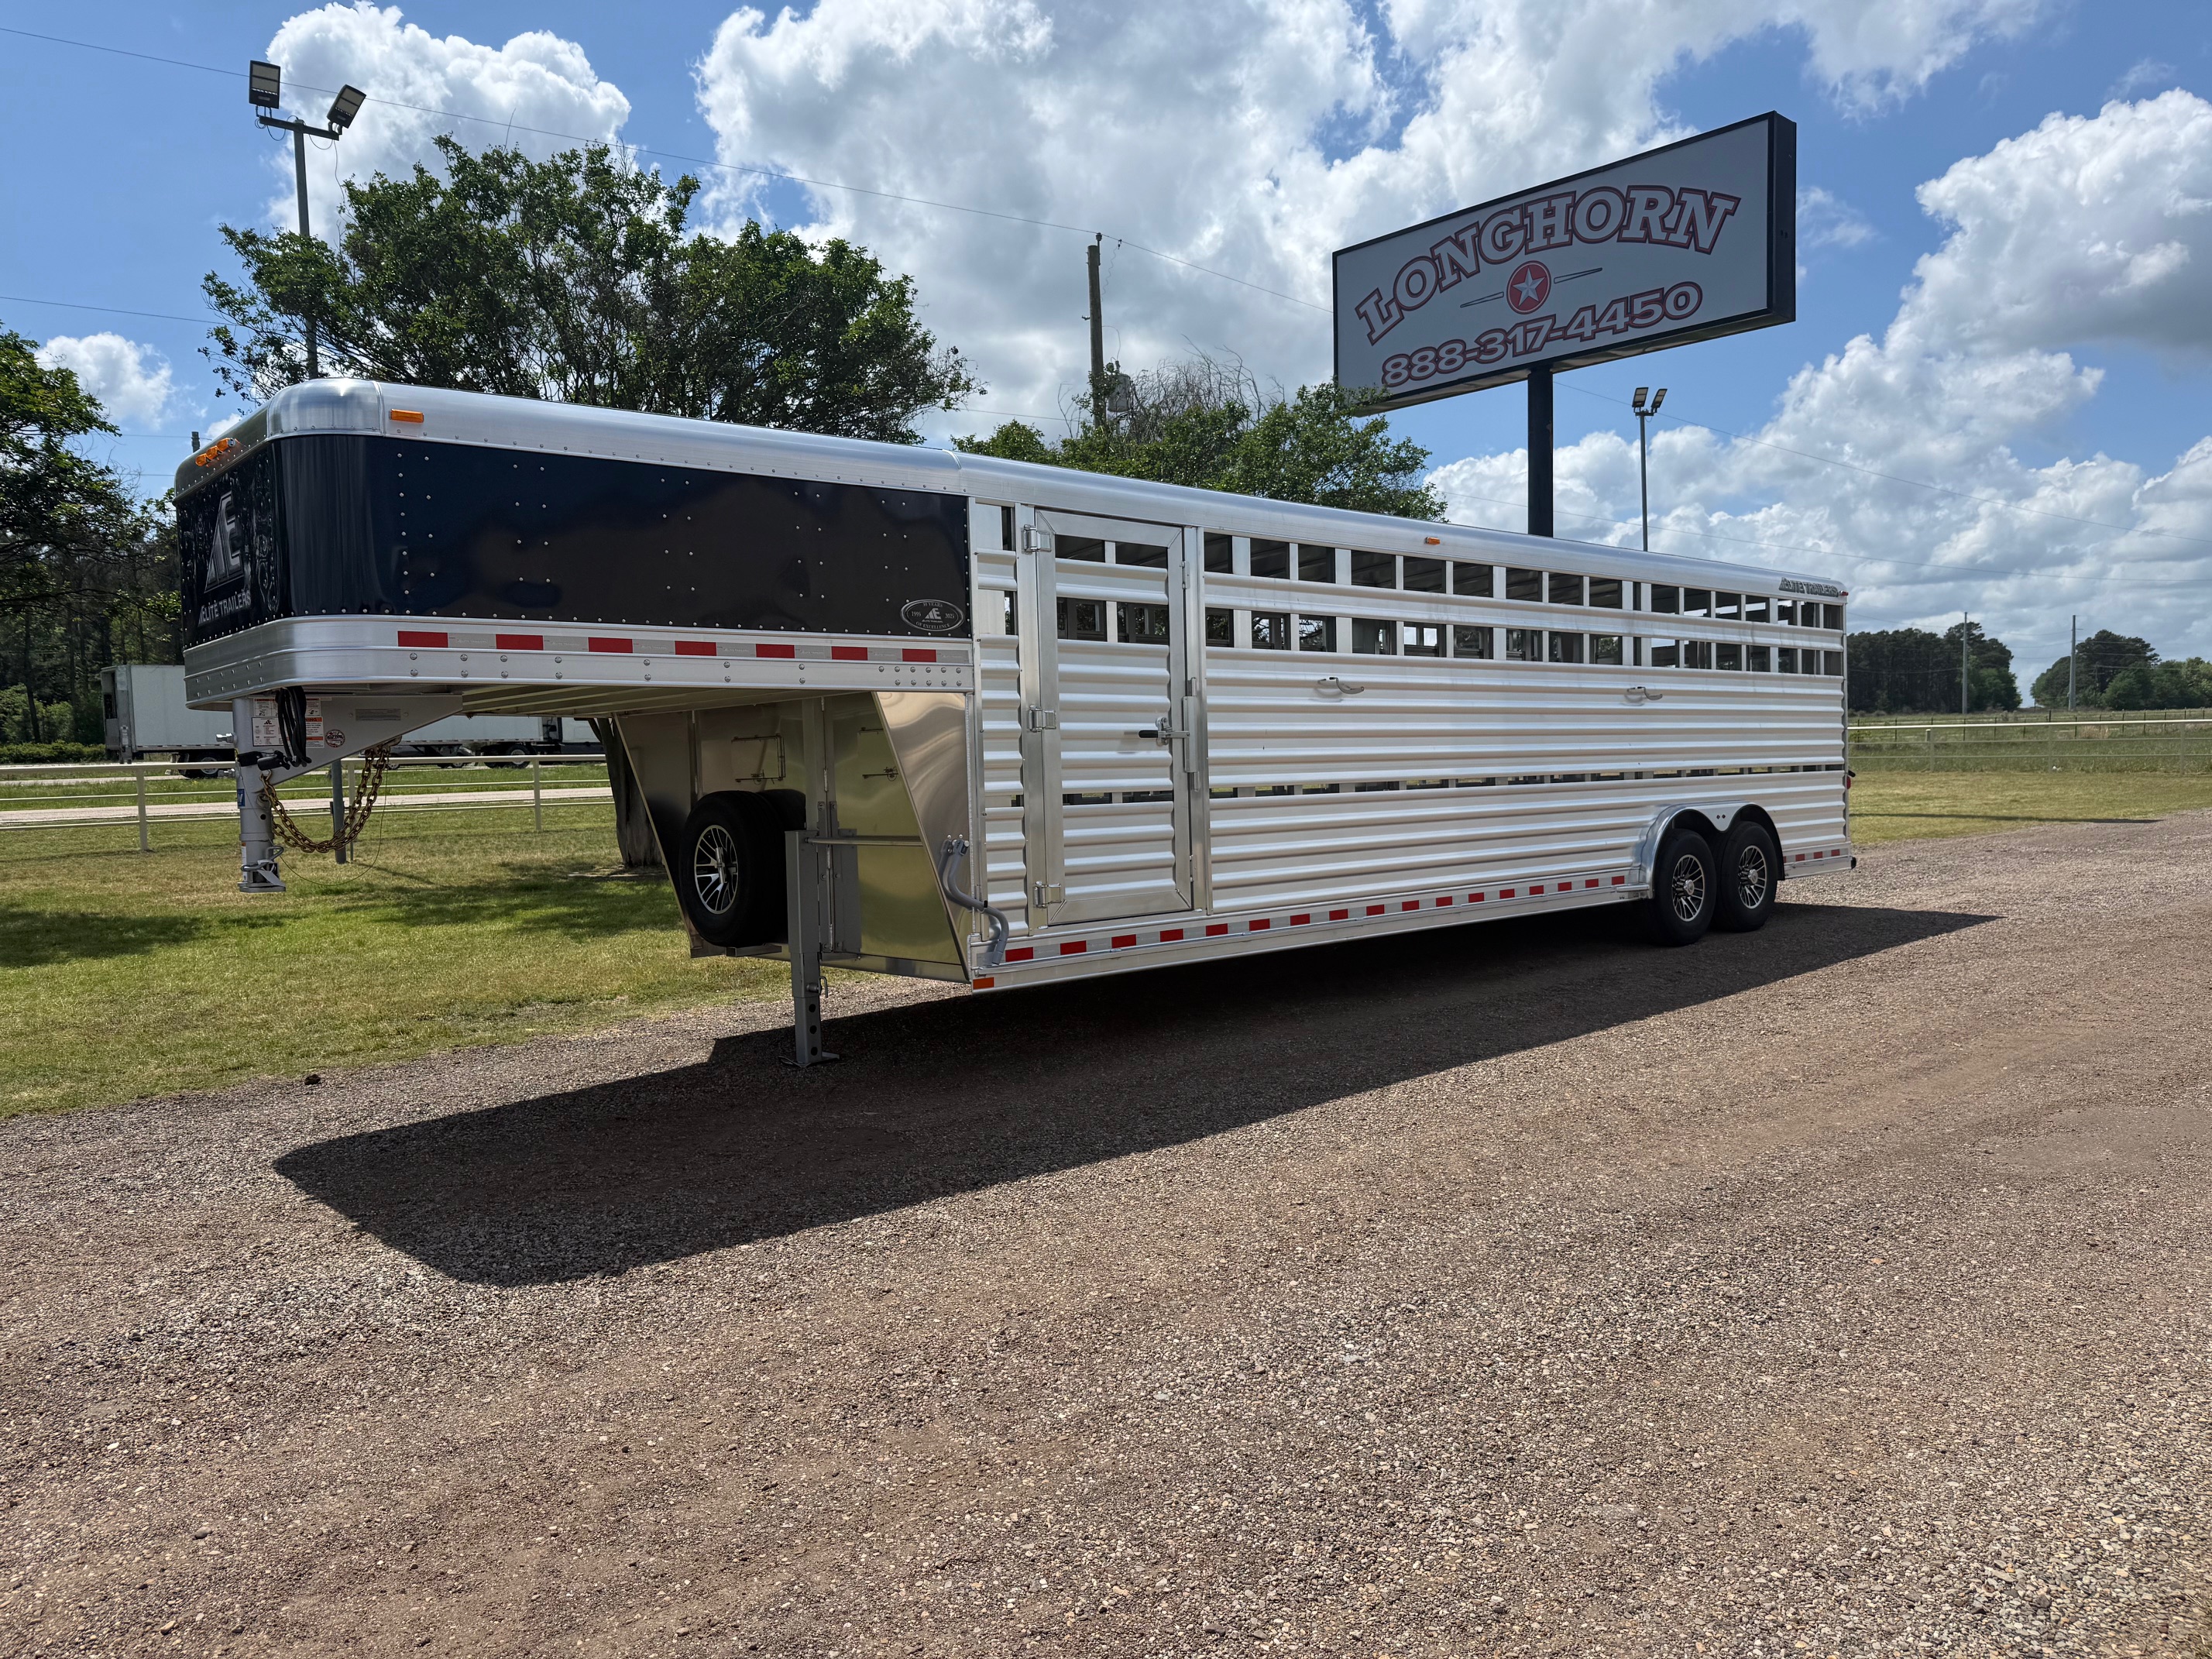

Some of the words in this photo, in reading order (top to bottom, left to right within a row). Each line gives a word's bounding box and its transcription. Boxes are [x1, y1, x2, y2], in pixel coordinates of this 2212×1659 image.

[1355, 184, 1742, 345] LONGHORN
[1382, 280, 1702, 387] 888-317-4450
[219, 590, 252, 616] TRAILERS
[1802, 582, 1839, 597] TRAILERS
